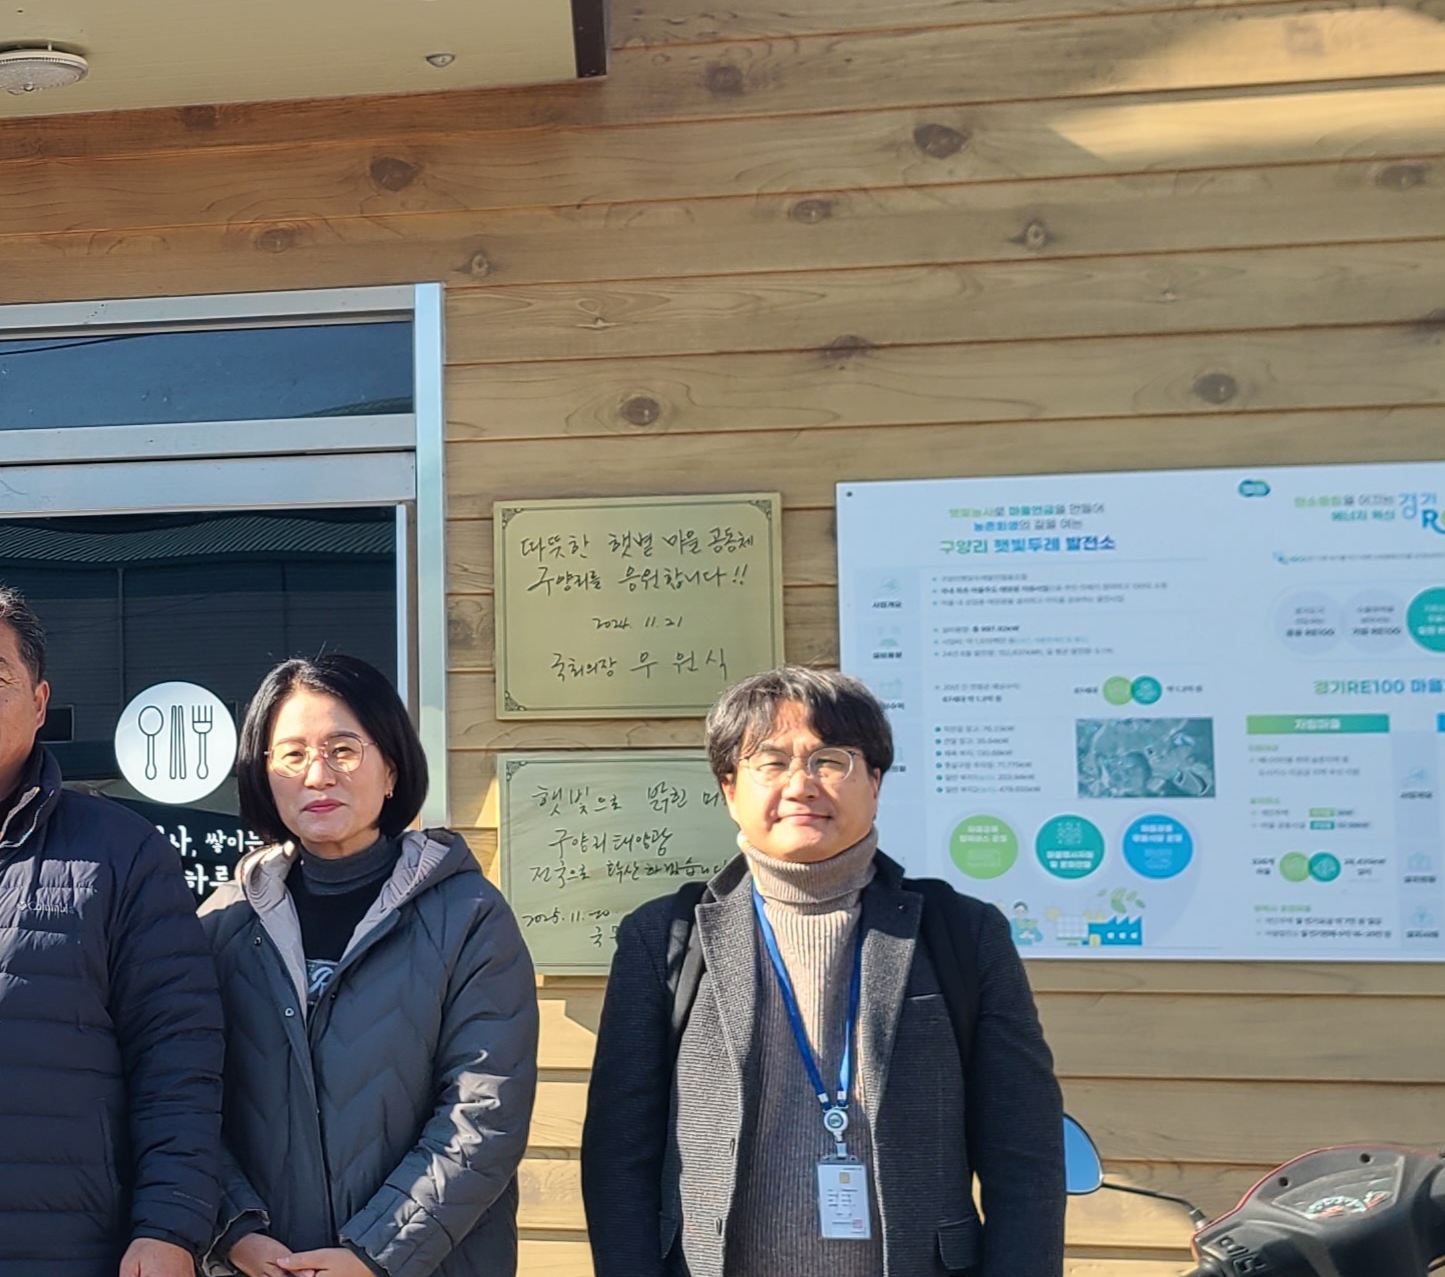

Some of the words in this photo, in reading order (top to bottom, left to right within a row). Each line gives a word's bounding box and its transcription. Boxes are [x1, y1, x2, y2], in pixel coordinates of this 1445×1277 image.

[520, 534, 590, 562] 따뜻한
[661, 529, 702, 555] 마을
[707, 527, 754, 554] 공동체
[940, 539, 988, 555] 구양리
[1065, 535, 1116, 552] 발전소
[527, 566, 602, 596] 구양리를
[551, 652, 617, 682] 국회의장
[1314, 679, 1405, 695] 경기RE100
[532, 786, 622, 816] 햇빛으로
[548, 829, 607, 859] 구양리
[612, 827, 673, 856] 태양광
[530, 860, 591, 888] 전국으로
